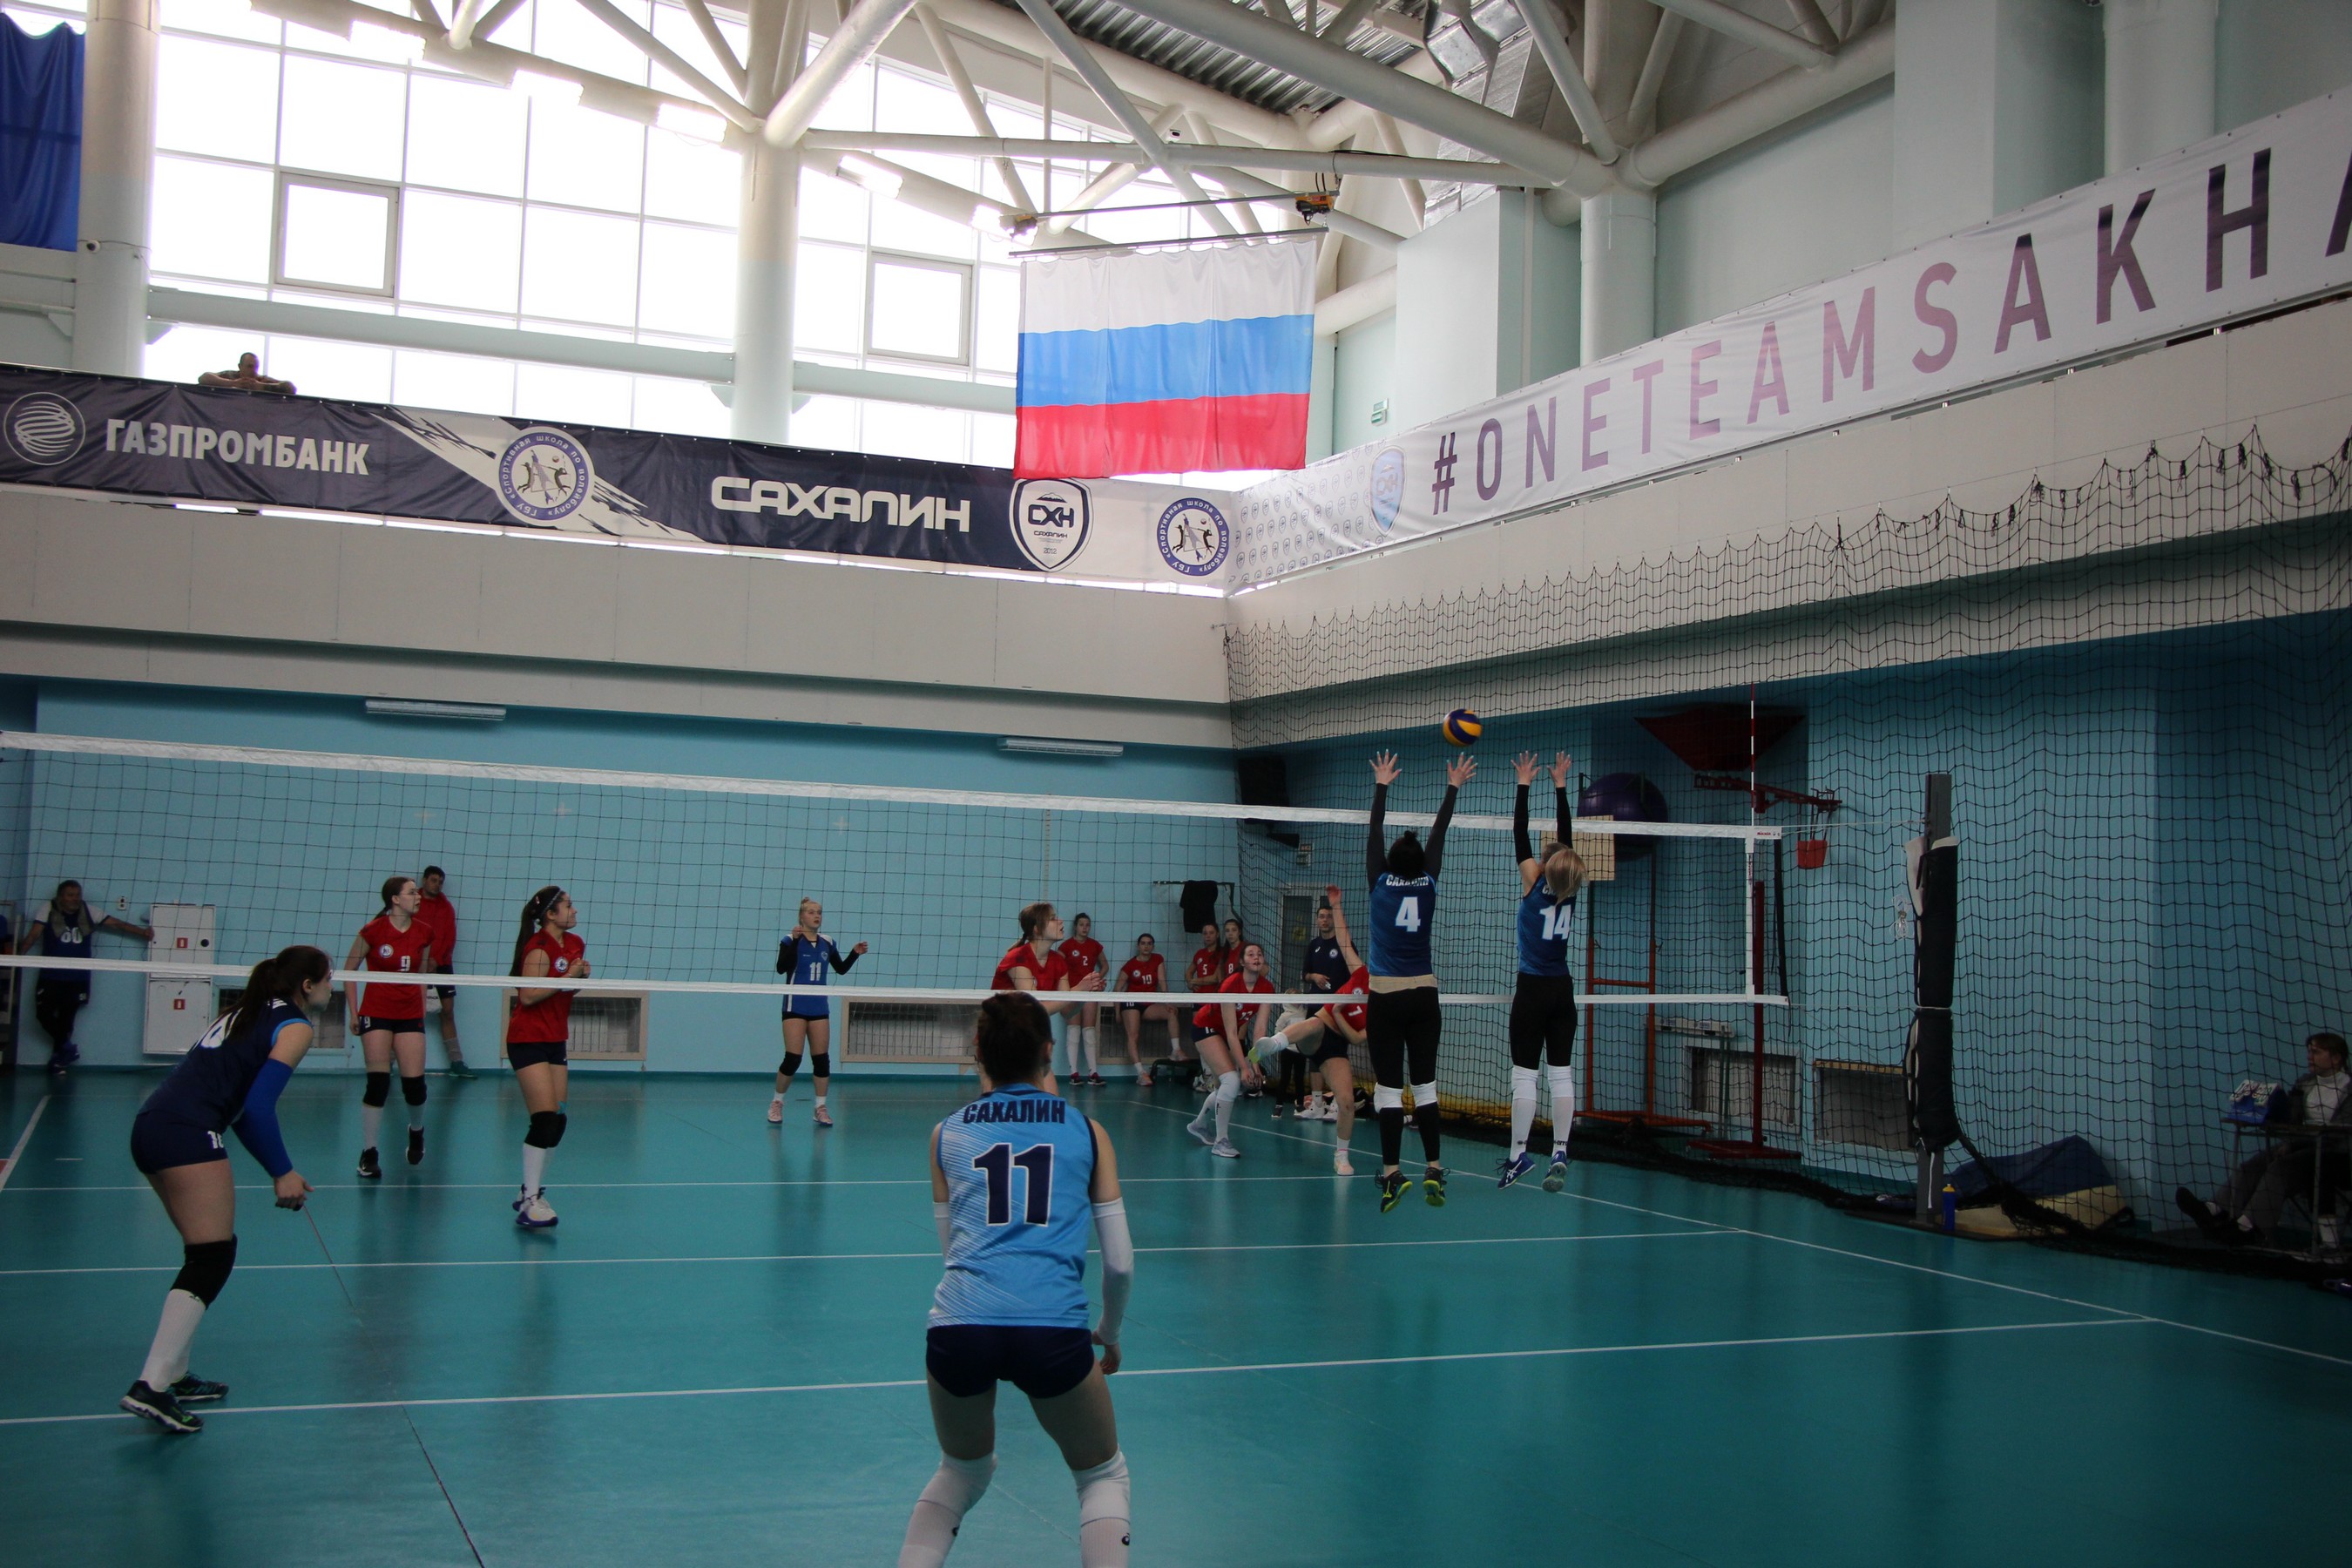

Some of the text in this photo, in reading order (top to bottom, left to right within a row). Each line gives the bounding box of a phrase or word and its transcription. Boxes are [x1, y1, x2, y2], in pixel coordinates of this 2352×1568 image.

[105, 418, 369, 476] ГАЗПРОМБАНК
[517, 503, 537, 517] ГБУ
[711, 476, 970, 532] САХАЛИН
[1172, 561, 1191, 573] ГБУ
[1395, 896, 1422, 932] 4
[1539, 904, 1571, 940] 14
[397, 955, 411, 972] 9
[1082, 956, 1088, 966] 2
[1202, 963, 1207, 975] 5
[1228, 963, 1233, 974] 8
[809, 962, 821, 981] 11
[963, 1099, 1065, 1124] САХАЛИН
[972, 1142, 1054, 1227] 11
